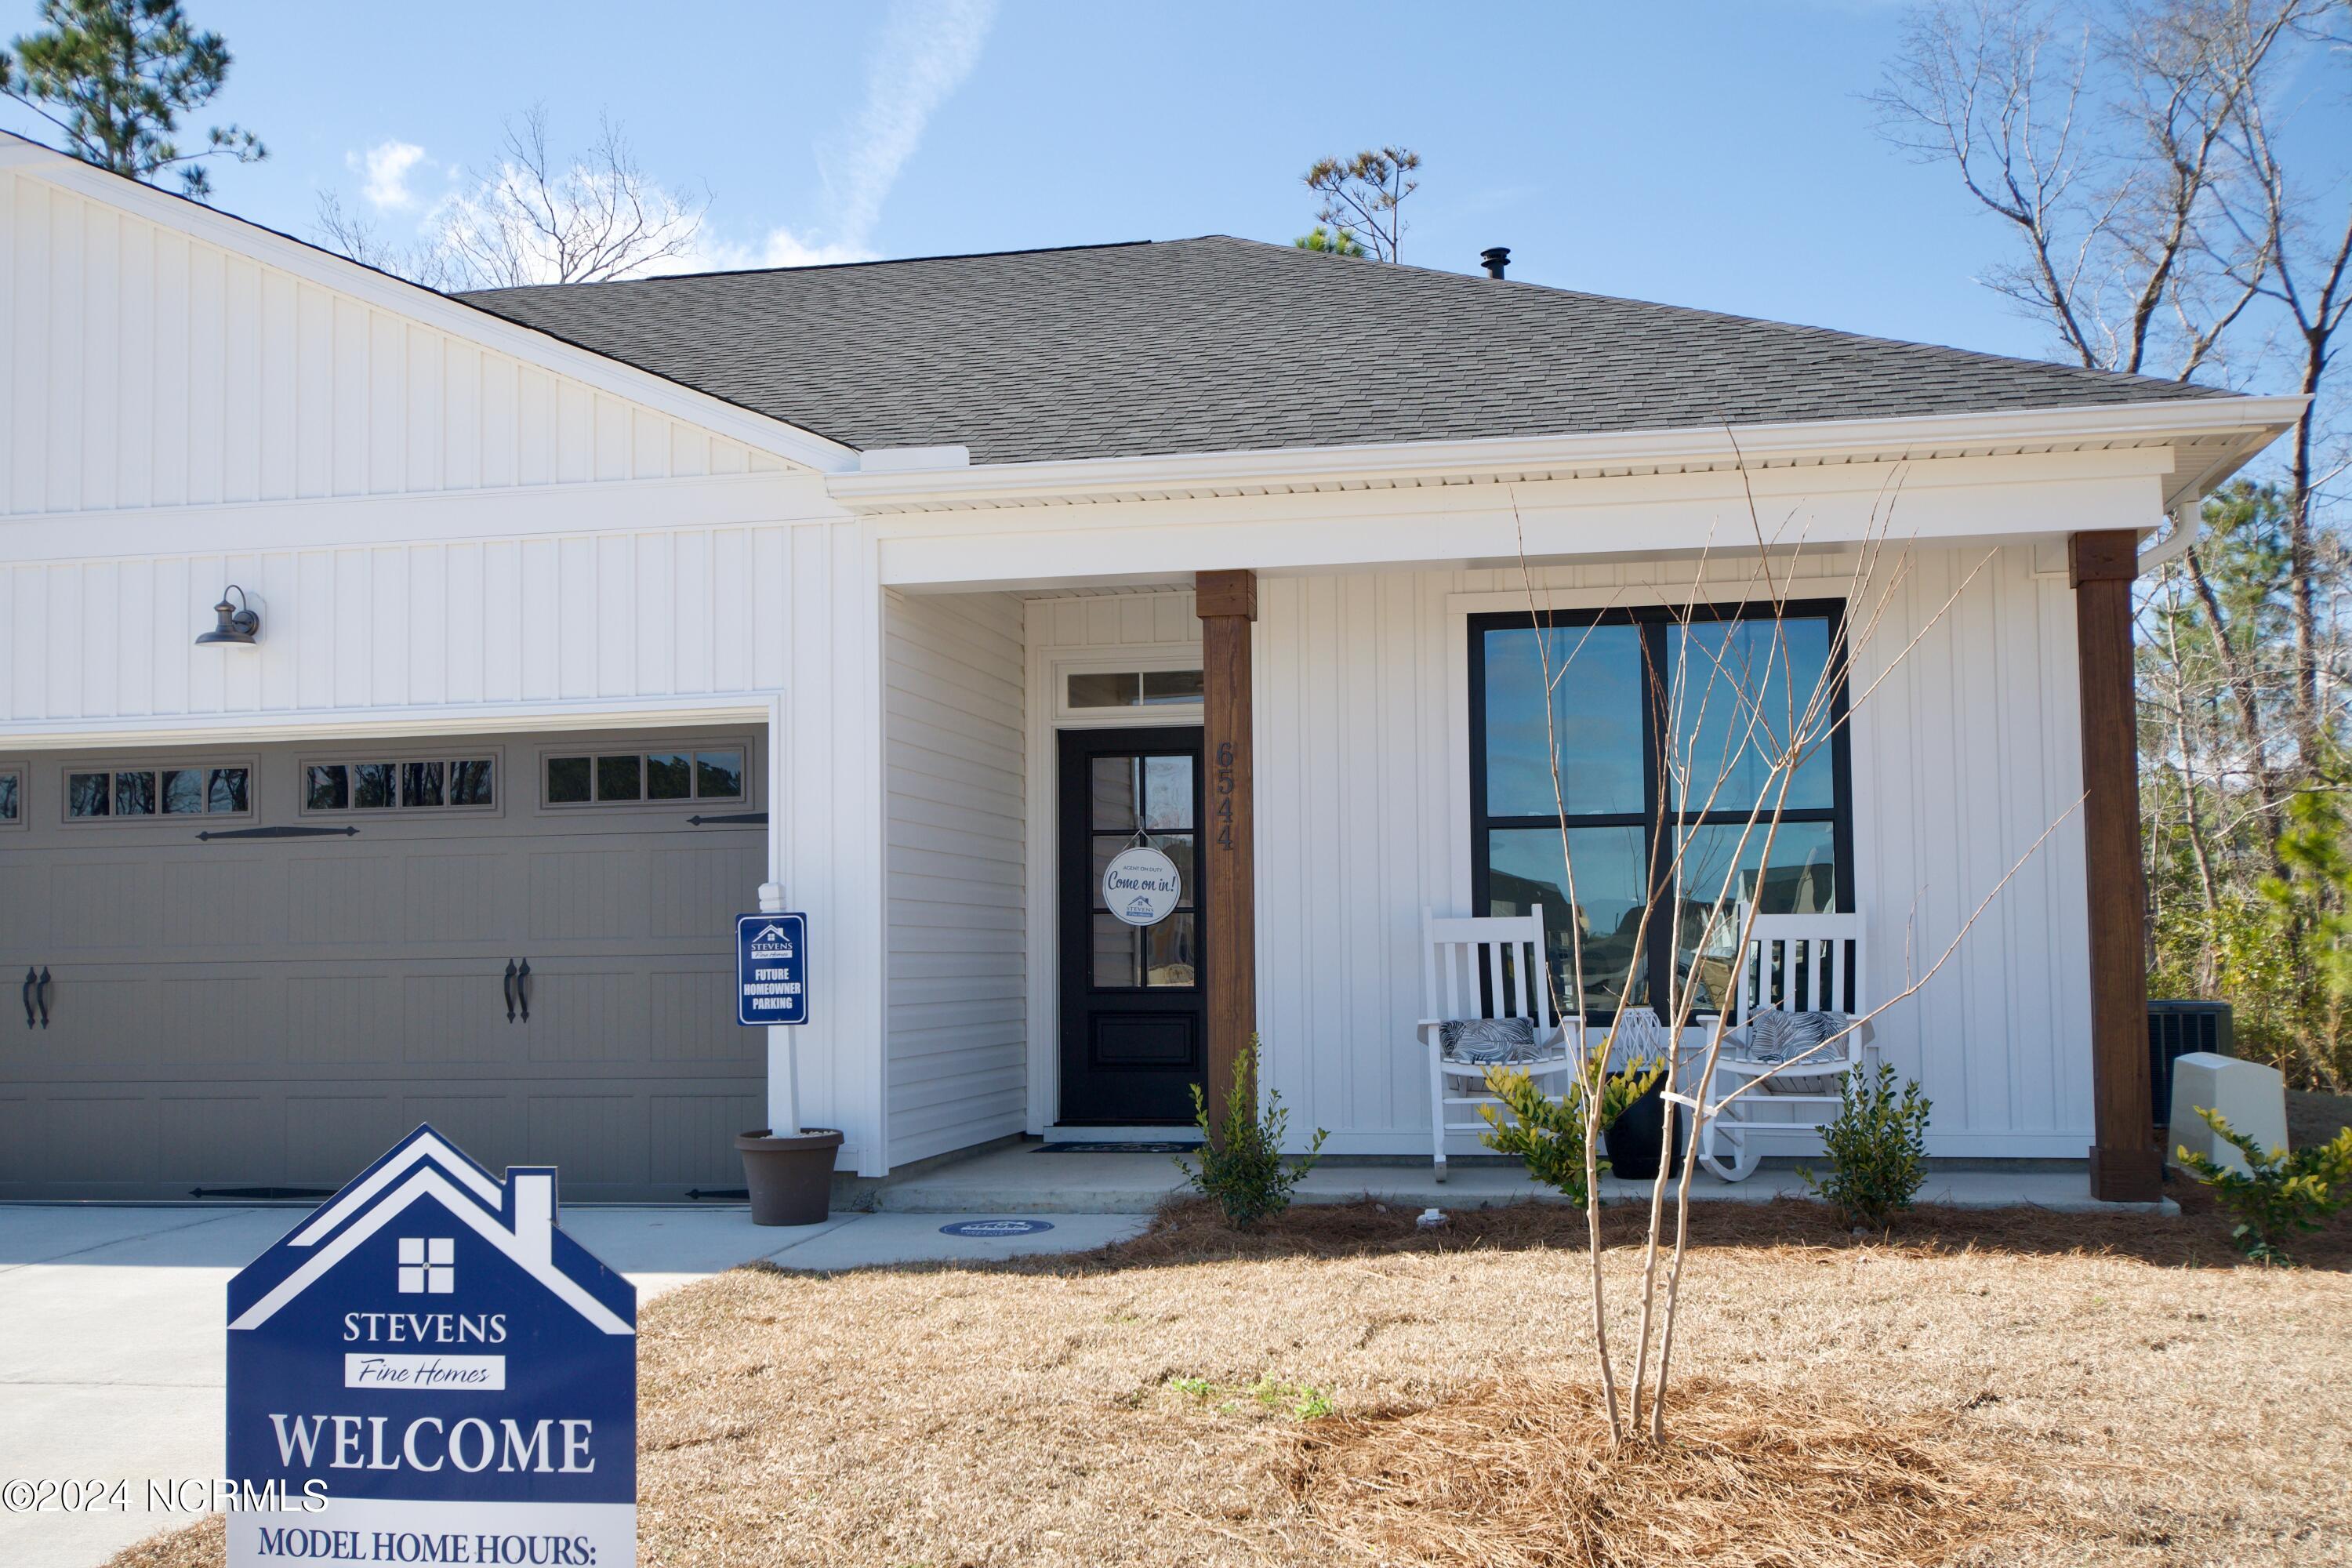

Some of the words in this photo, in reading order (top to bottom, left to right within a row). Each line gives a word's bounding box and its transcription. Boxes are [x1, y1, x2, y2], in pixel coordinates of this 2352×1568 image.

[1217, 742, 1234, 851] 6544
[1108, 870, 1139, 891] Come
[1142, 880, 1156, 891] on
[1159, 876, 1177, 892] in!
[751, 942, 793, 951] STEVENS
[755, 968, 789, 981] FUTURE
[744, 982, 801, 996] HOMEOWNER
[753, 997, 793, 1010] PARKING
[343, 1312, 506, 1343] STEVENS
[358, 1357, 408, 1383] Fine
[414, 1359, 490, 1384] Homes
[269, 1414, 596, 1474] WELCOME
[258, 1527, 366, 1561] MODEL
[372, 1532, 470, 1563] HOME
[474, 1535, 597, 1566] HOURS:
